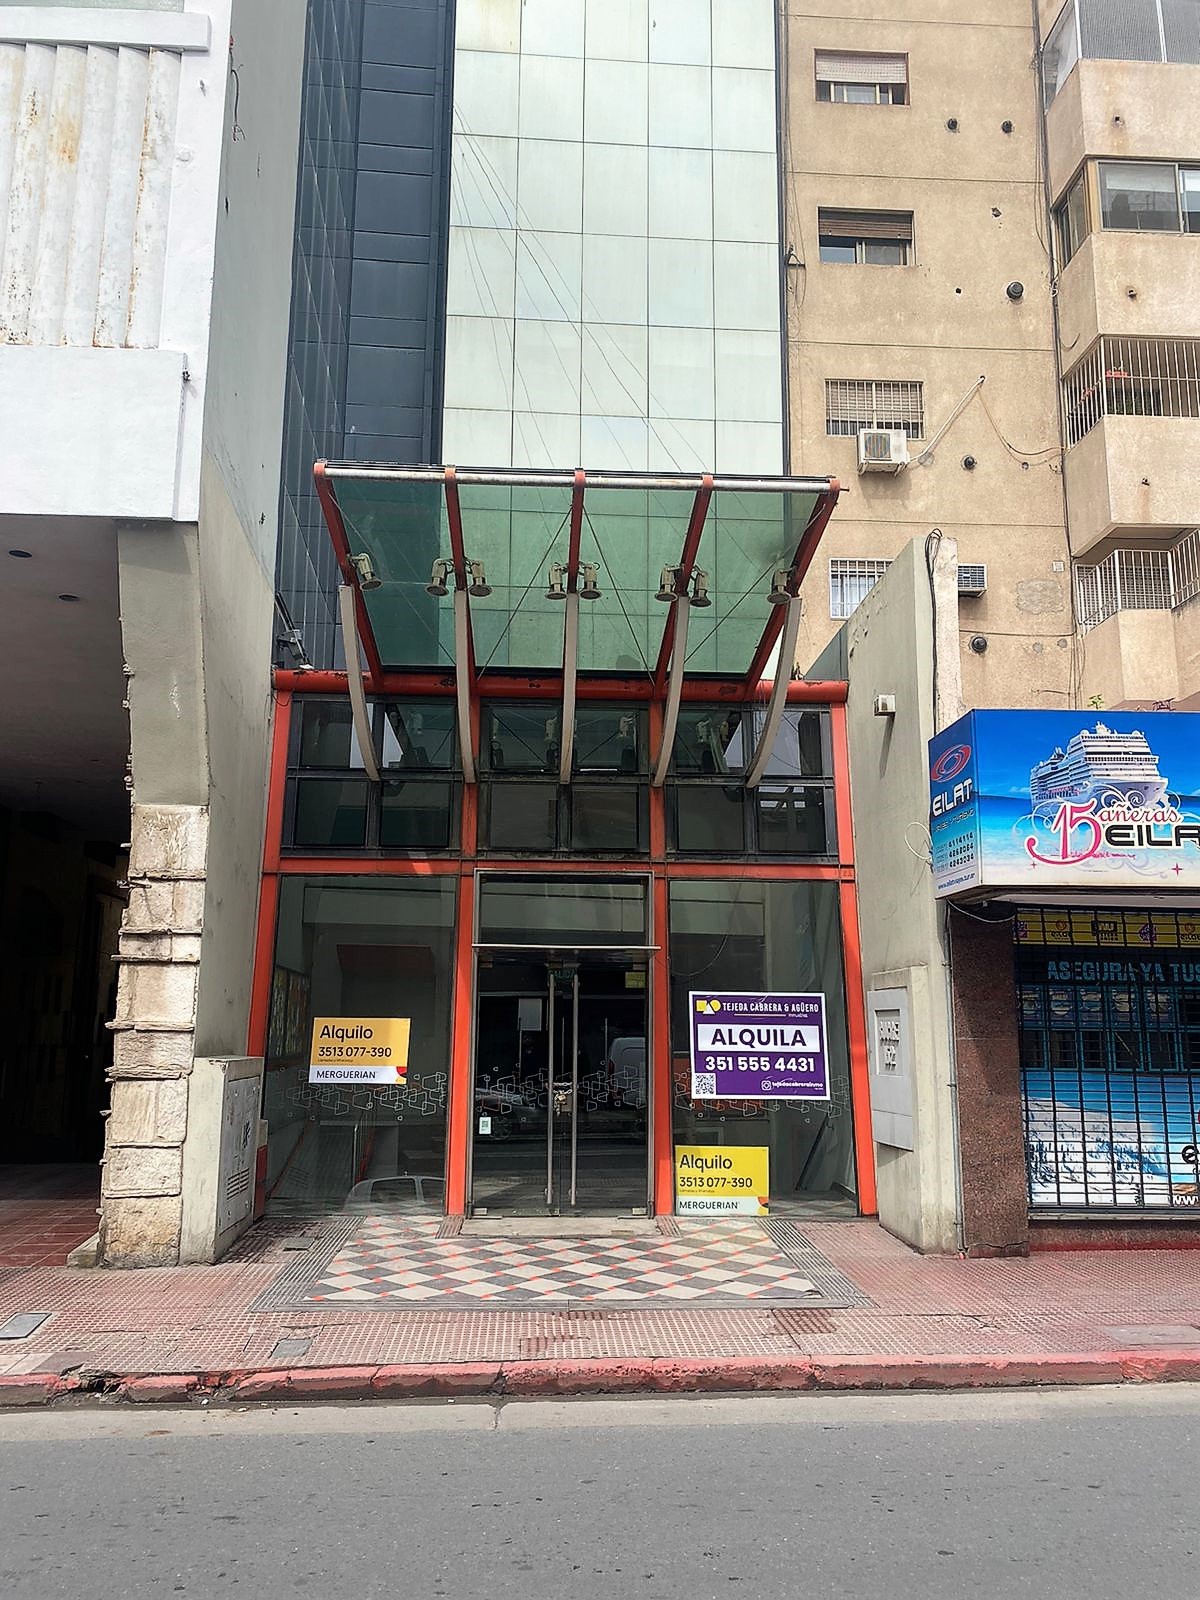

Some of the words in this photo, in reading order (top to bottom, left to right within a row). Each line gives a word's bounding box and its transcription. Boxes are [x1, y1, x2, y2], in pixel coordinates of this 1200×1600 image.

[932, 778, 973, 816] EILAT
[1099, 803, 1182, 823] añeras
[1025, 799, 1102, 866] 15
[1047, 960, 1136, 982] ASEGURA
[1140, 961, 1165, 982] YA
[722, 1002, 748, 1012] TEJEDA
[749, 1002, 783, 1012] CABRERA
[783, 1002, 790, 1012] &
[791, 1001, 819, 1013] AGÜERO
[319, 1024, 374, 1042] Alquilo
[711, 1028, 807, 1049] ALQUILA
[318, 1046, 343, 1057] 3513
[345, 1046, 392, 1058] 077-390
[705, 1056, 733, 1071] 351
[737, 1056, 770, 1071] 555
[775, 1056, 815, 1072] 4431
[316, 1070, 376, 1079] MERGUERIAN
[679, 1154, 733, 1173] Alquilo
[679, 1176, 704, 1188] 3513
[706, 1177, 753, 1188] 077-390
[679, 1200, 739, 1210] MERGUERIAN
